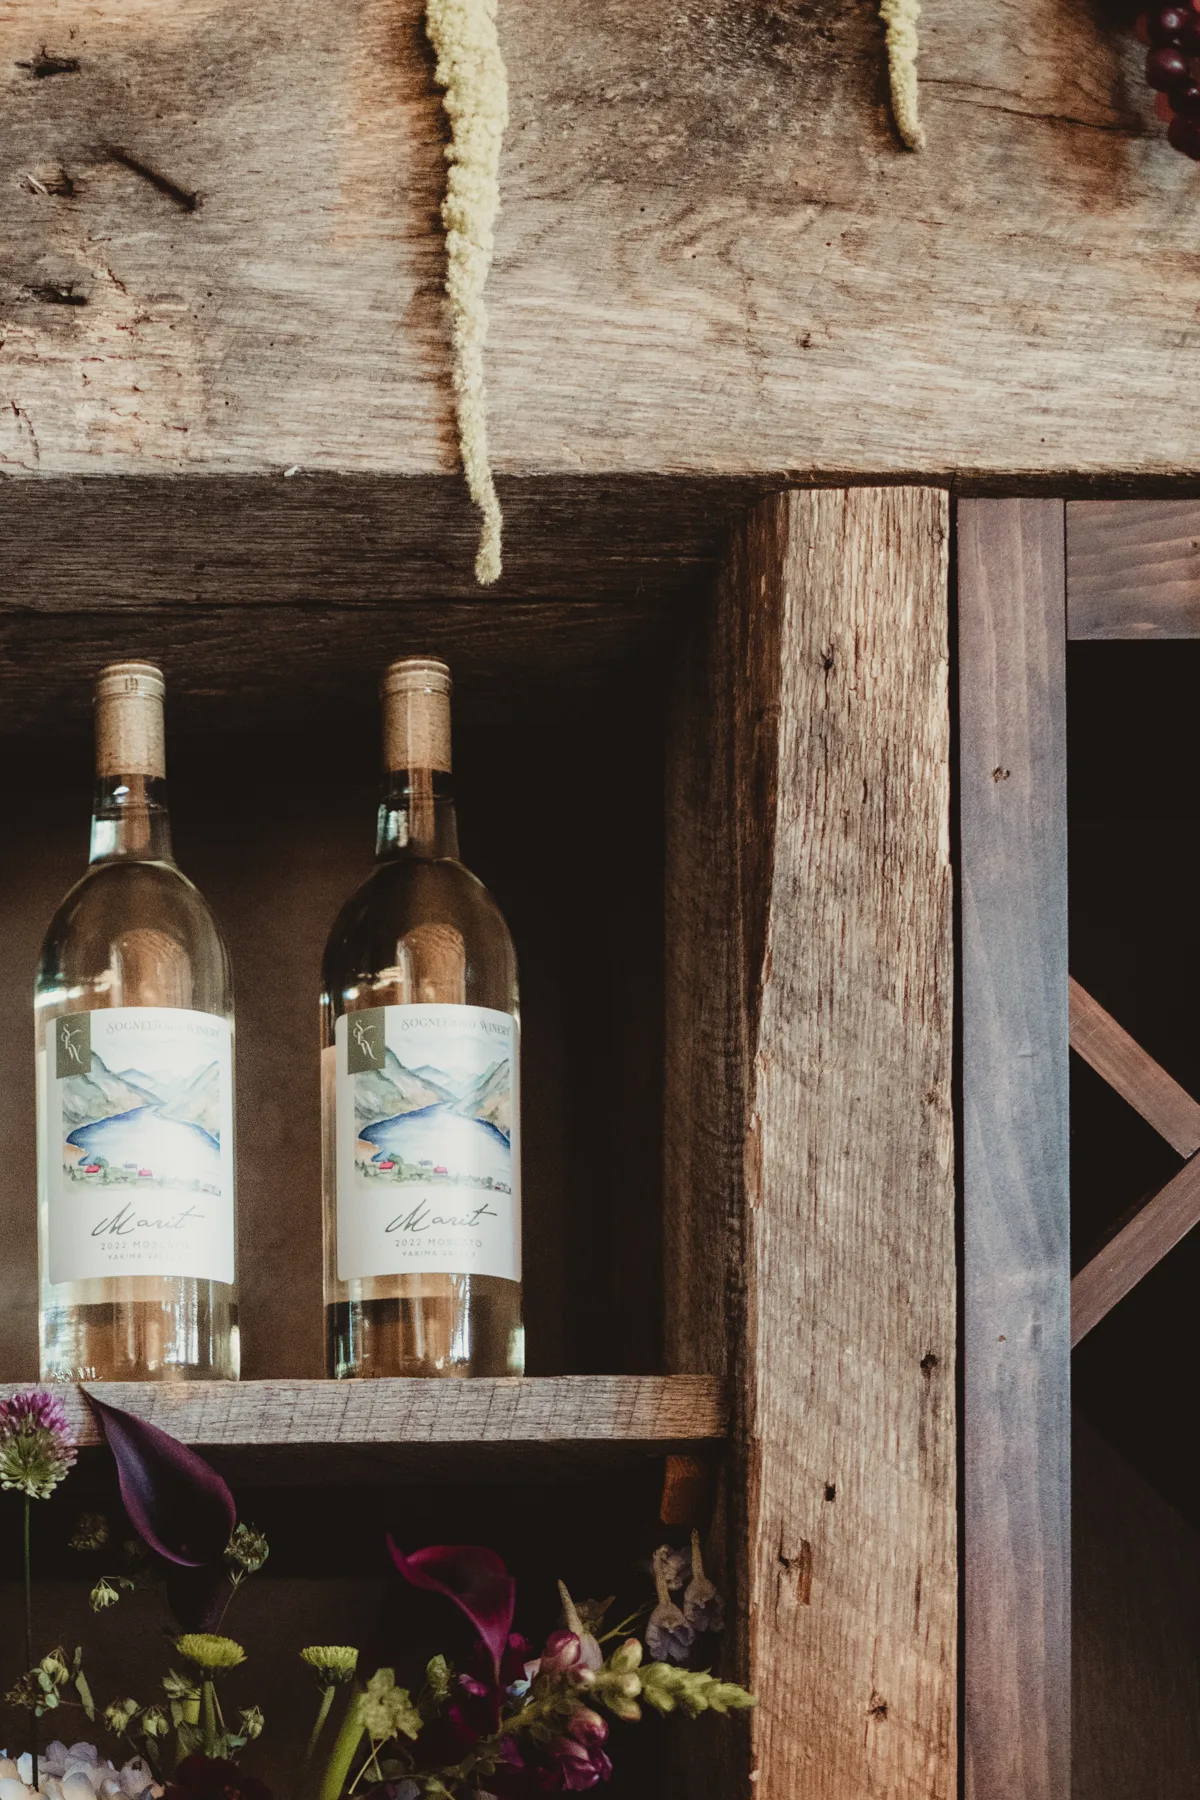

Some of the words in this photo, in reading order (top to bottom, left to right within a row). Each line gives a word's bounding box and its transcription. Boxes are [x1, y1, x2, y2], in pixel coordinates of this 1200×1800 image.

[479, 1019, 511, 1037] WINERY
[91, 1202, 205, 1237] Marit
[385, 1198, 498, 1233] Marit
[100, 1242, 127, 1251] 2022
[395, 1238, 422, 1248] 2022
[107, 1253, 143, 1261] YAKIMA
[147, 1252, 182, 1261] VALL
[402, 1250, 438, 1258] YAKIMA
[442, 1249, 477, 1258] VAY
